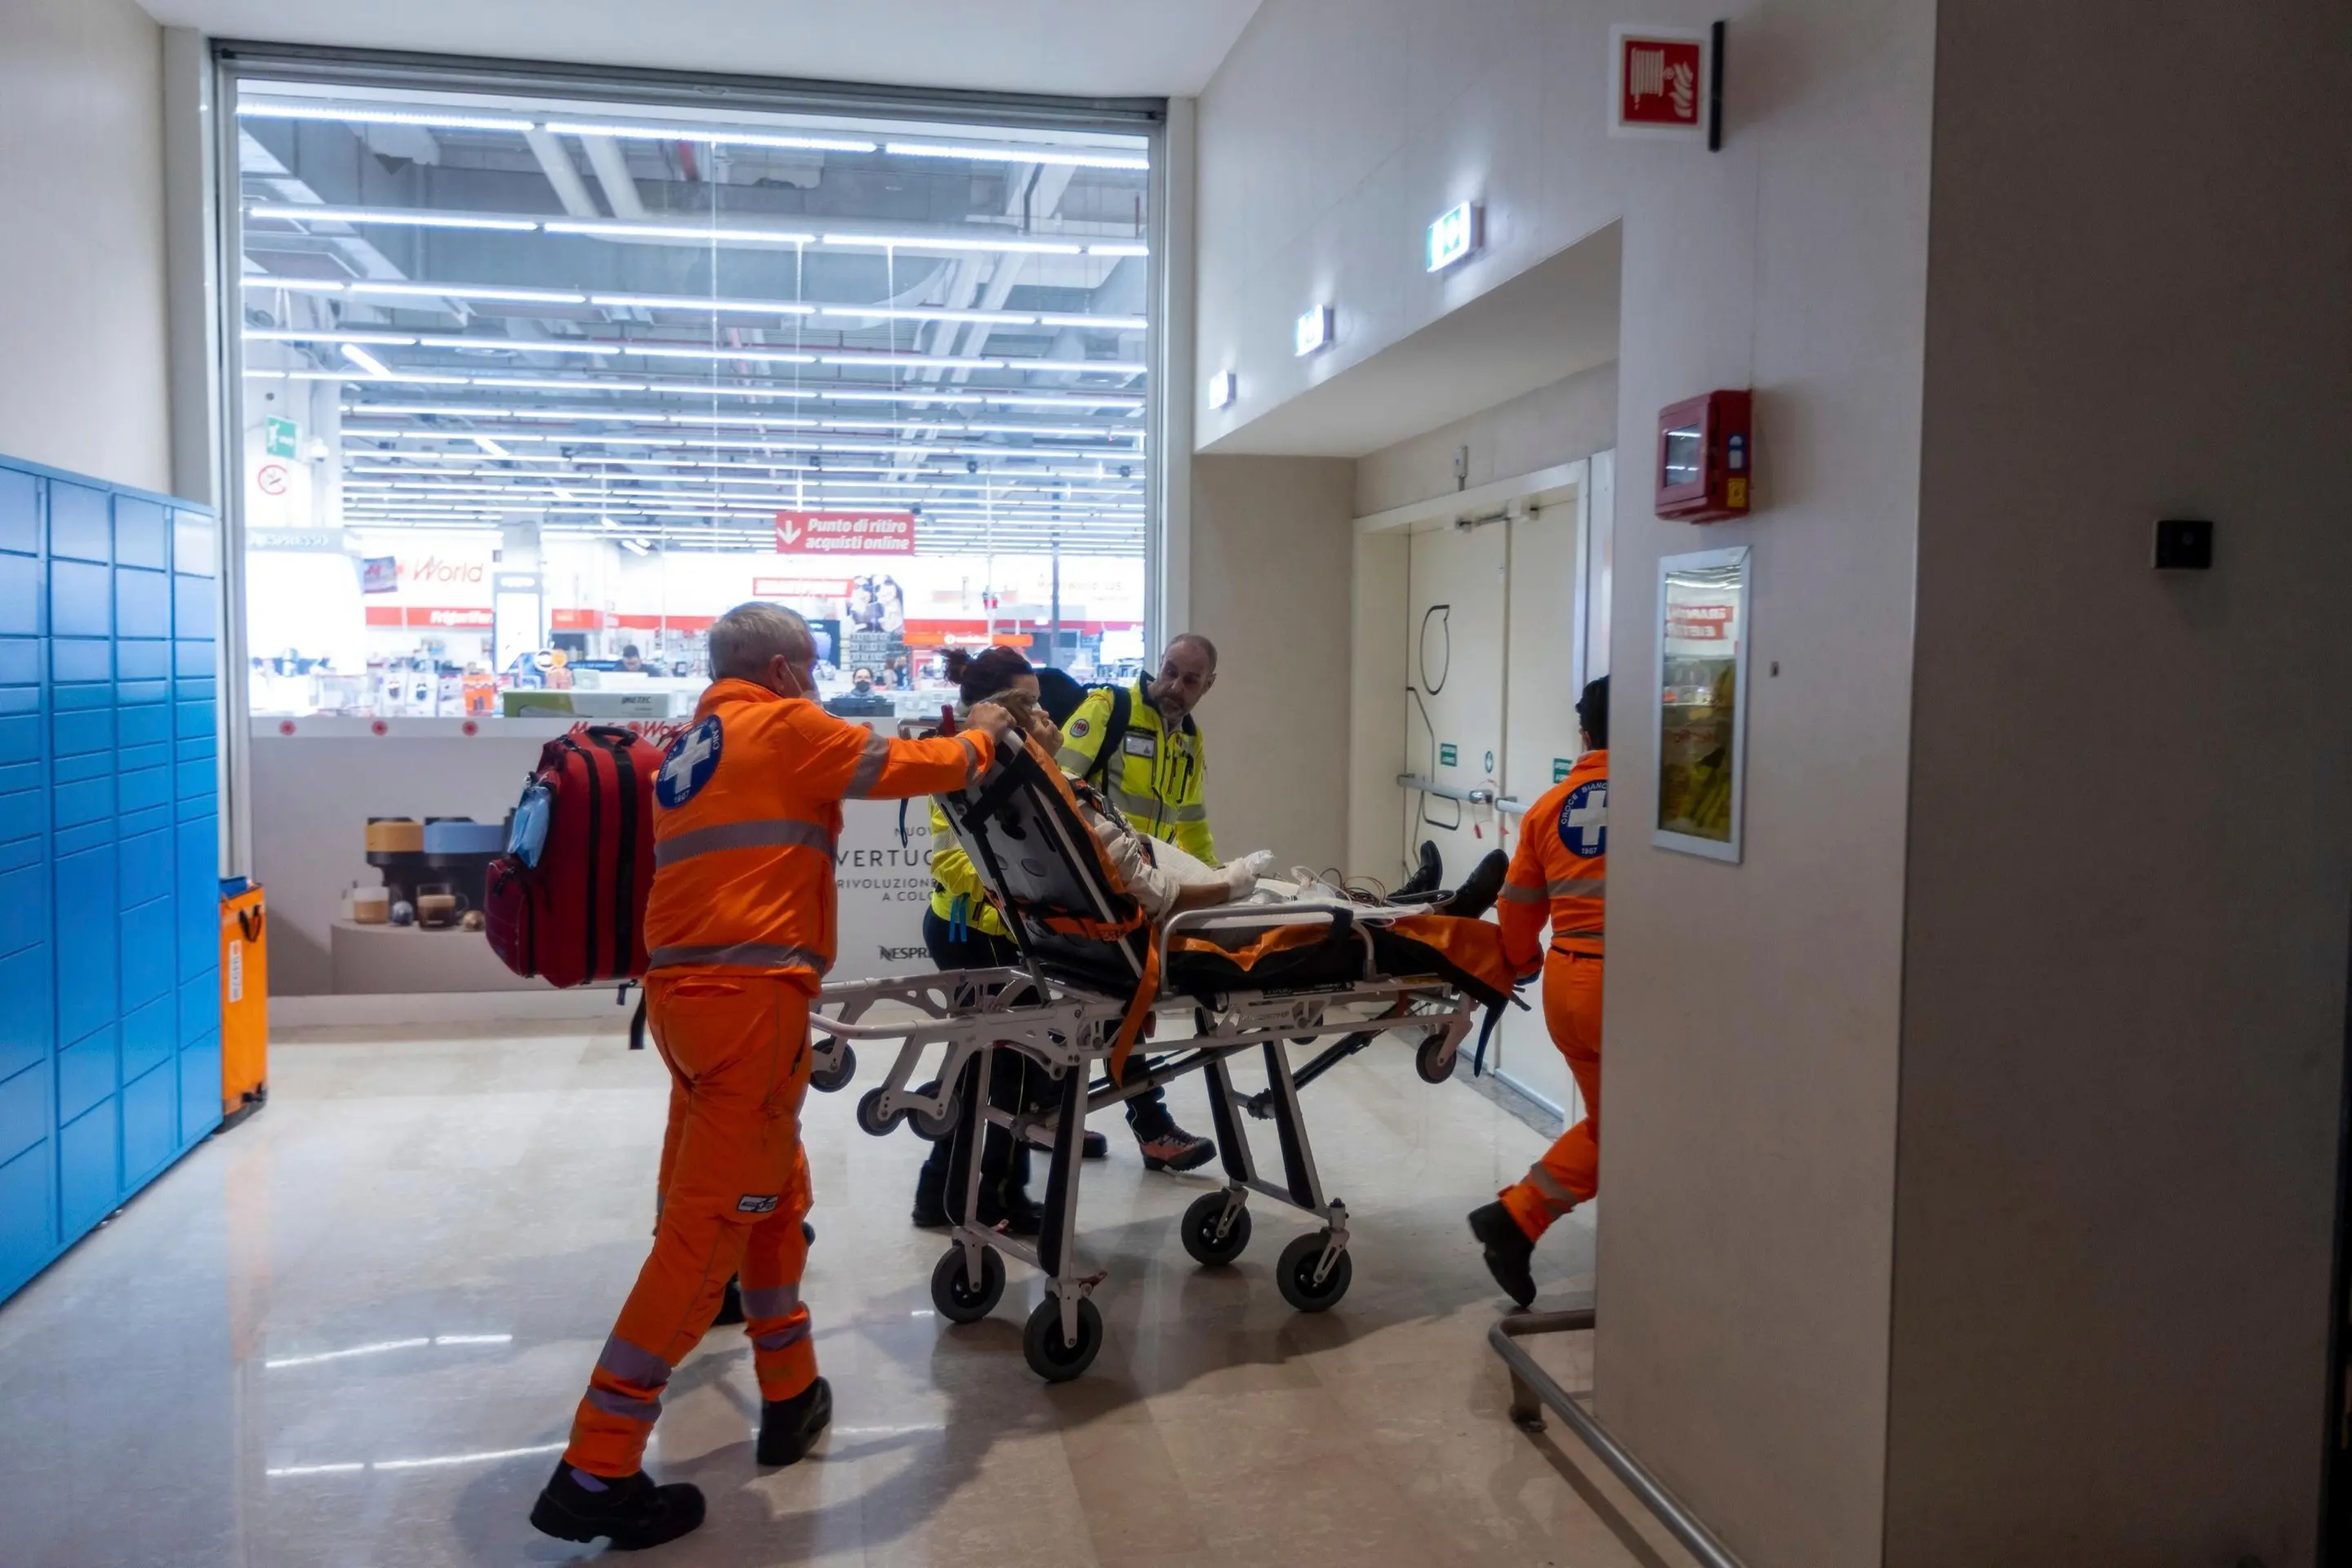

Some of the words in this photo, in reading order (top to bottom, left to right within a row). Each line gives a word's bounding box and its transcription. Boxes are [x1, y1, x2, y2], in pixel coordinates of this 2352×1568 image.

[807, 518, 852, 532] Punto
[853, 519, 869, 532] di
[869, 519, 907, 532] ritiro
[805, 536, 863, 551] acquisti
[863, 536, 911, 550] online
[413, 555, 483, 582] World
[1561, 793, 1579, 825] CROCE
[1581, 782, 1607, 794] BIANC
[894, 826, 933, 837] NUOV
[837, 878, 937, 889] RIVOLUZIONE
[882, 892, 891, 901] A
[897, 891, 933, 901] COLO
[877, 945, 932, 962] NESPR
